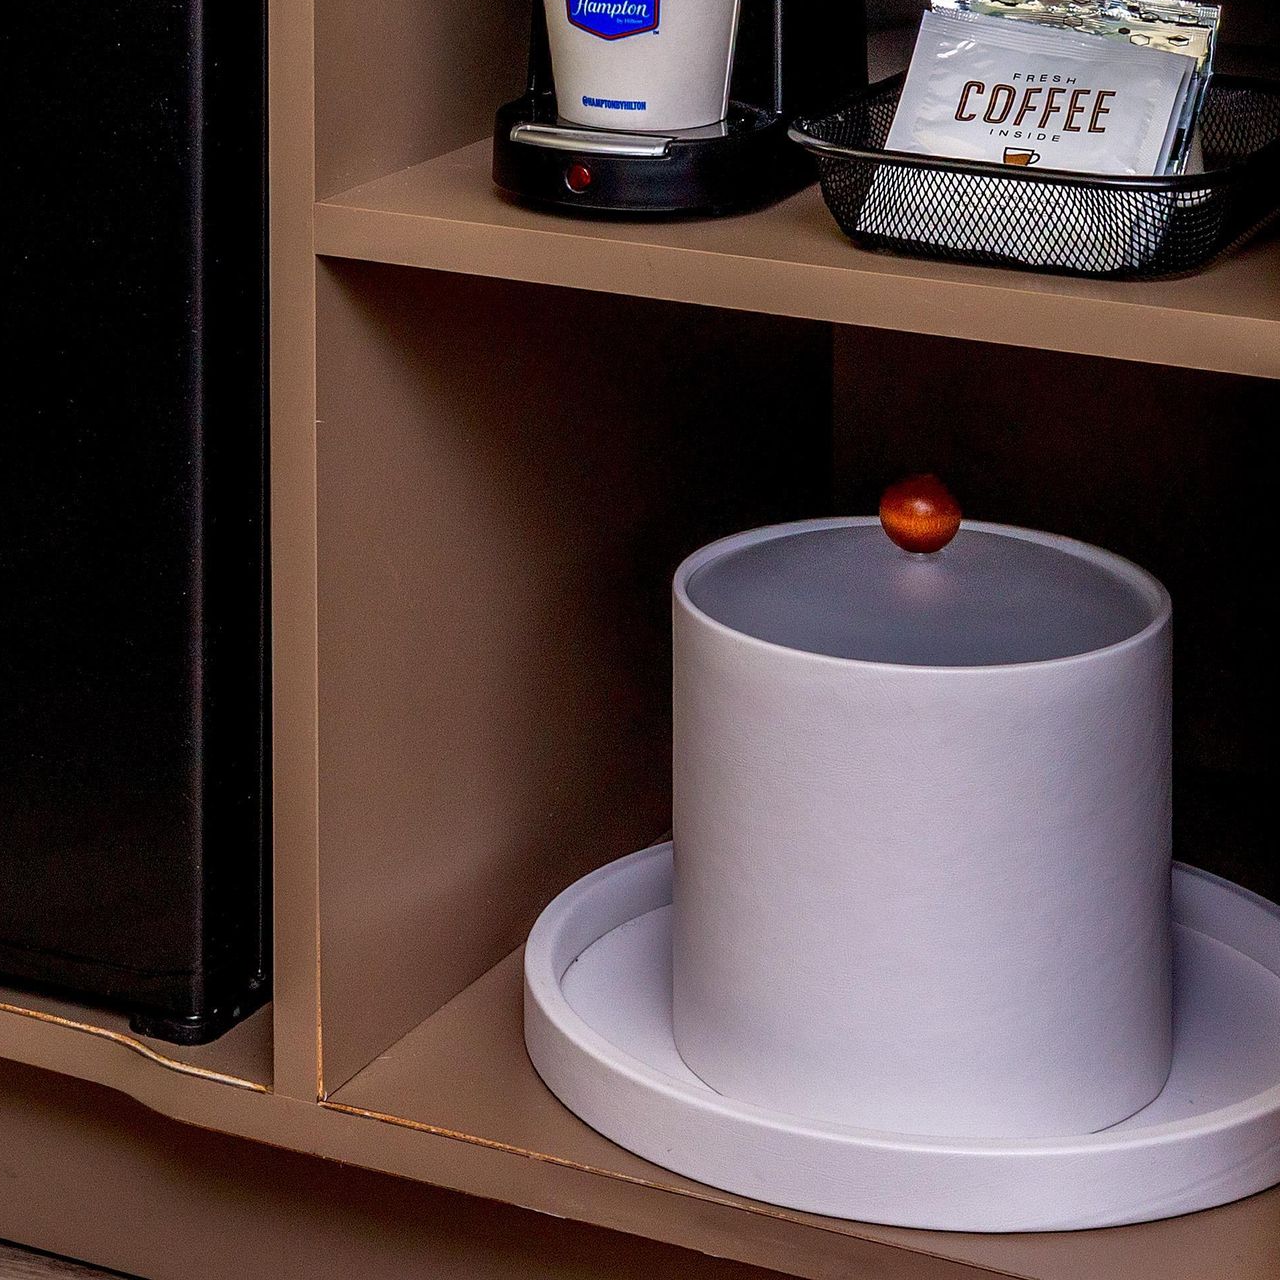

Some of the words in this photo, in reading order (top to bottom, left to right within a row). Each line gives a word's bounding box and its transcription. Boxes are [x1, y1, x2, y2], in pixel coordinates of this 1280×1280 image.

[1012, 72, 1078, 85] FRESH
[954, 80, 1117, 134] COFFEE
[989, 128, 1062, 143] INSIDE
